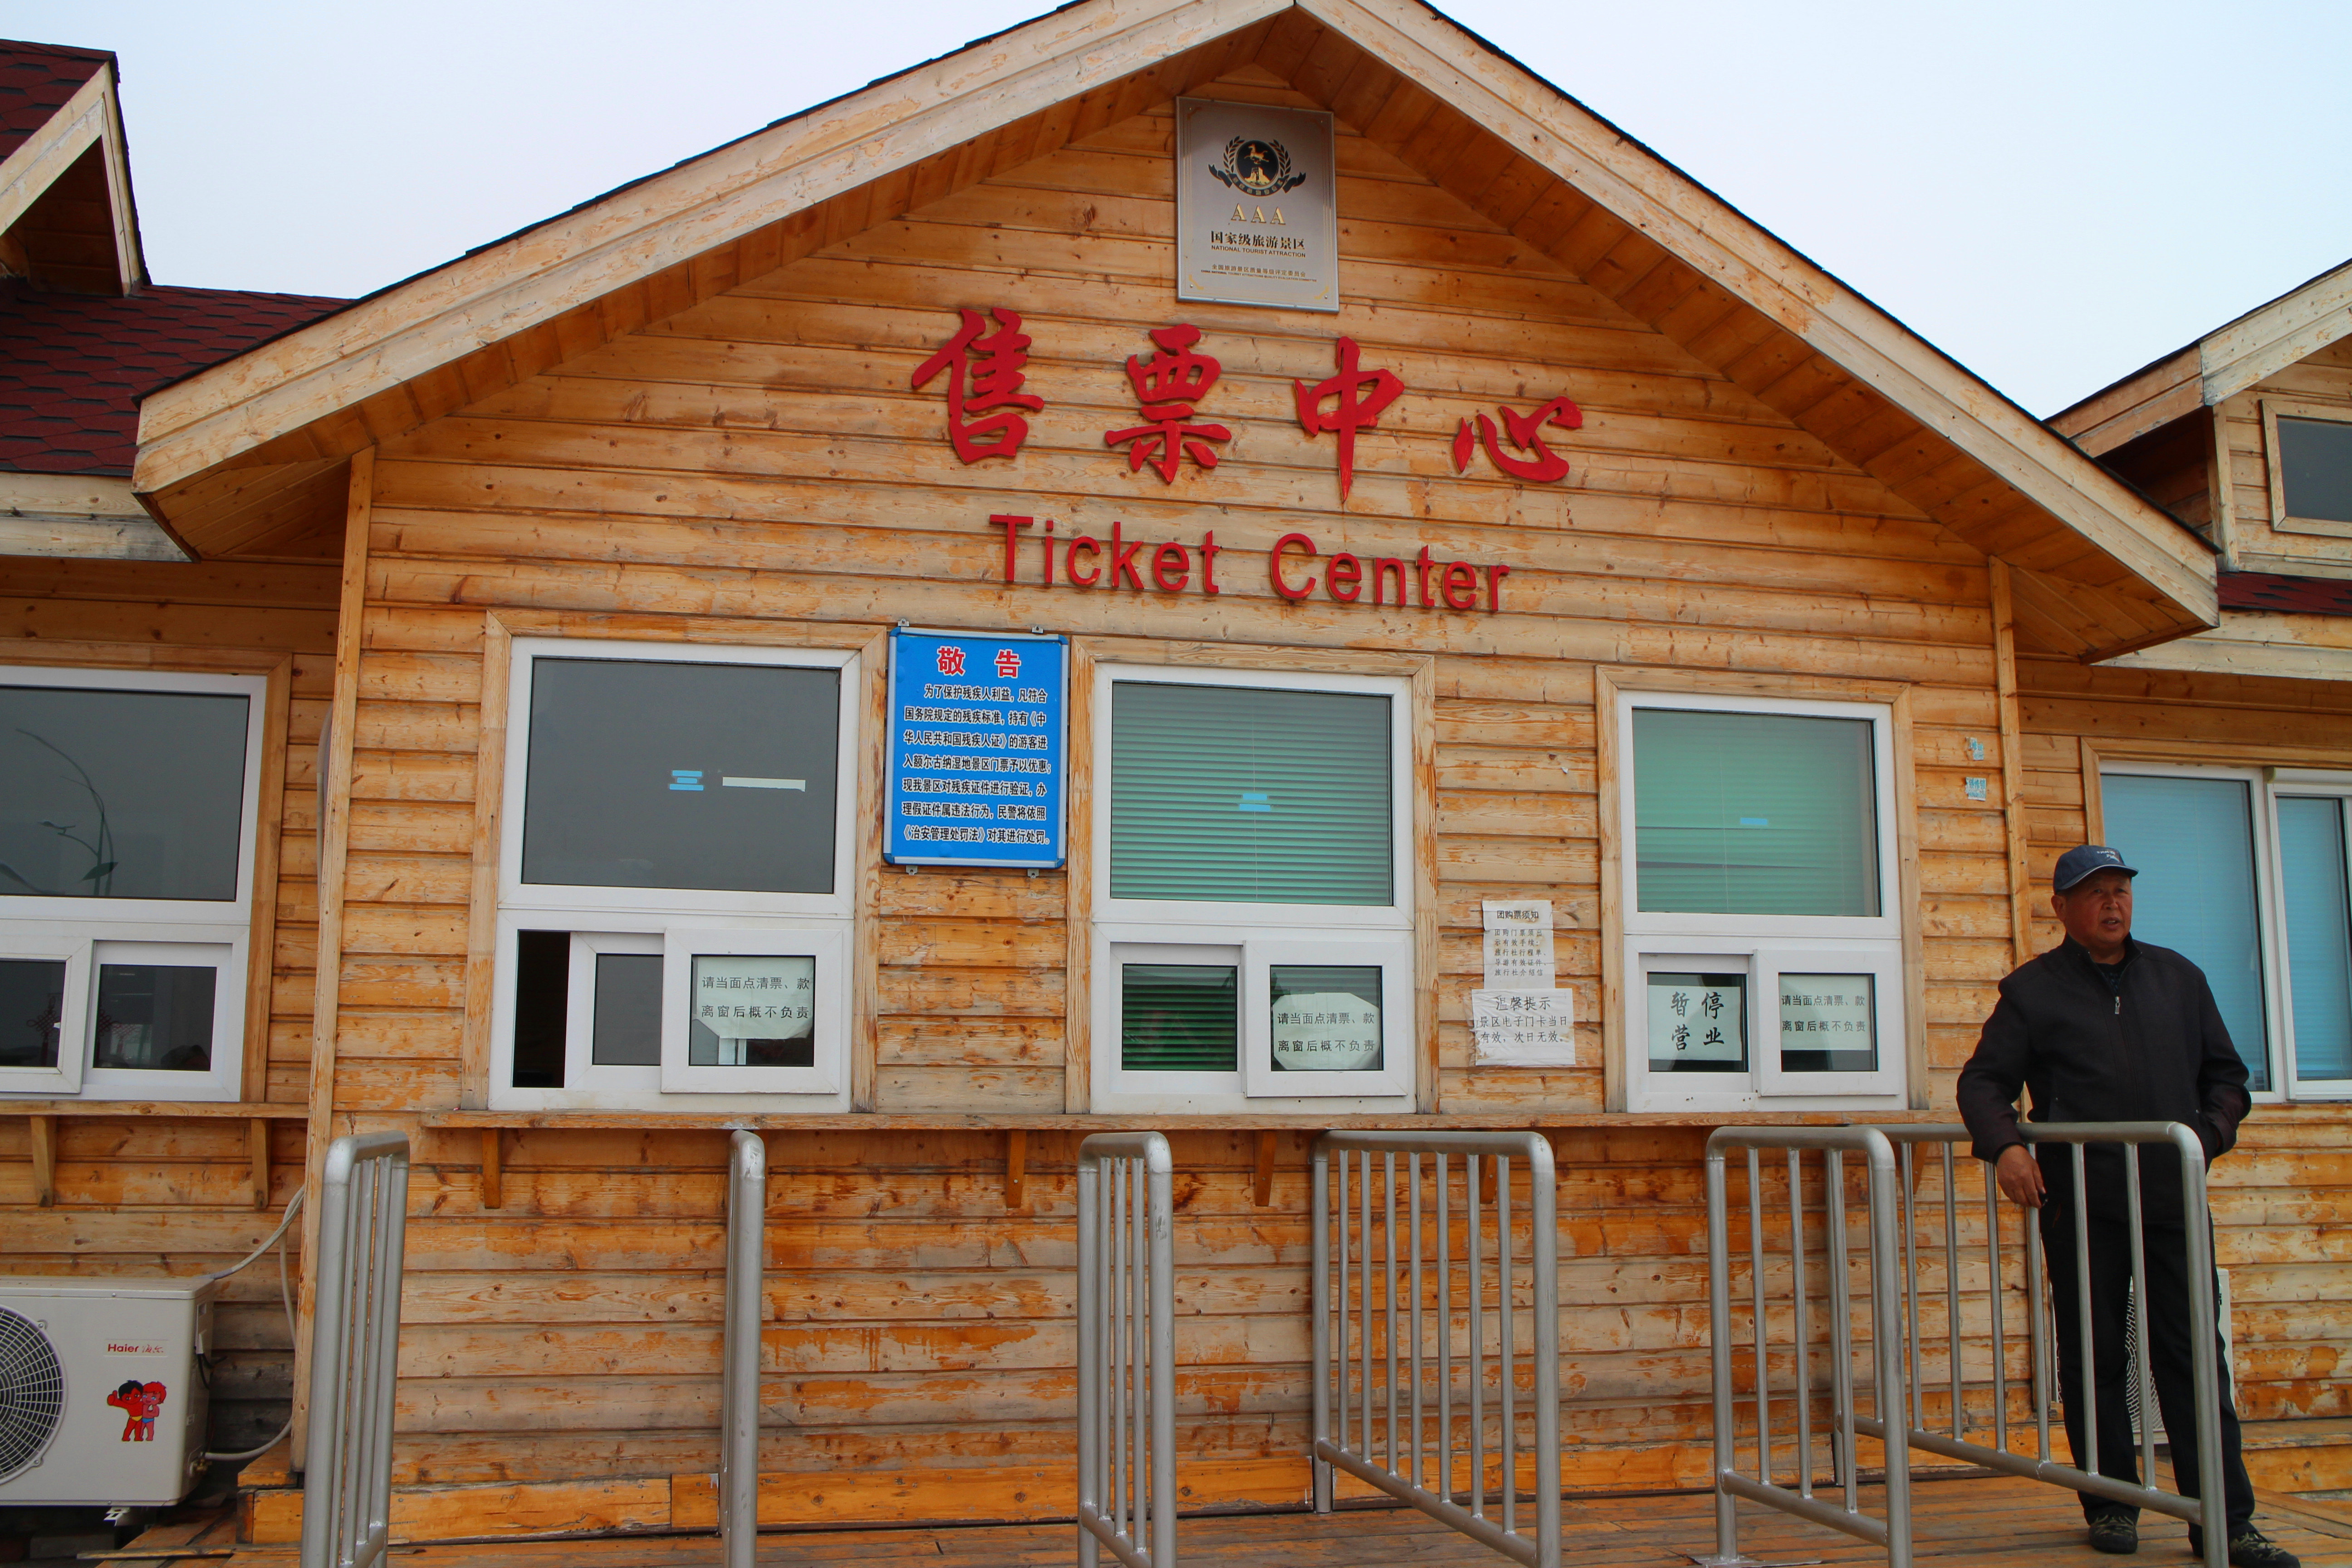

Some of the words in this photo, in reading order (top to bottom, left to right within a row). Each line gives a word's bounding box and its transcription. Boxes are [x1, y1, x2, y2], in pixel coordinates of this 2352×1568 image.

[1211, 230, 1305, 250] 国家级旅游景区
[912, 307, 1583, 503] 售票中心
[990, 514, 1220, 594] Ticket
[1270, 533, 1510, 612] Center
[936, 647, 1021, 678] 敬告
[924, 684, 1047, 703] 为了保护残疾人利益，凡符合
[904, 730, 1047, 750] 华人民共和国残疾人证》的游客进
[1497, 910, 1539, 919] 团购票须知
[701, 1004, 809, 1019] 离窗后概不负责
[1496, 996, 1551, 1011] 温馨提示
[1671, 991, 1725, 1019] 暂停
[1480, 1015, 1567, 1028] 景区电子门卡当日
[1782, 1019, 1866, 1033] 离窗后概不负责
[1278, 1039, 1375, 1052] 离窗后概不负责
[1671, 1024, 1725, 1051] 营业
[108, 1343, 139, 1352] Haier
